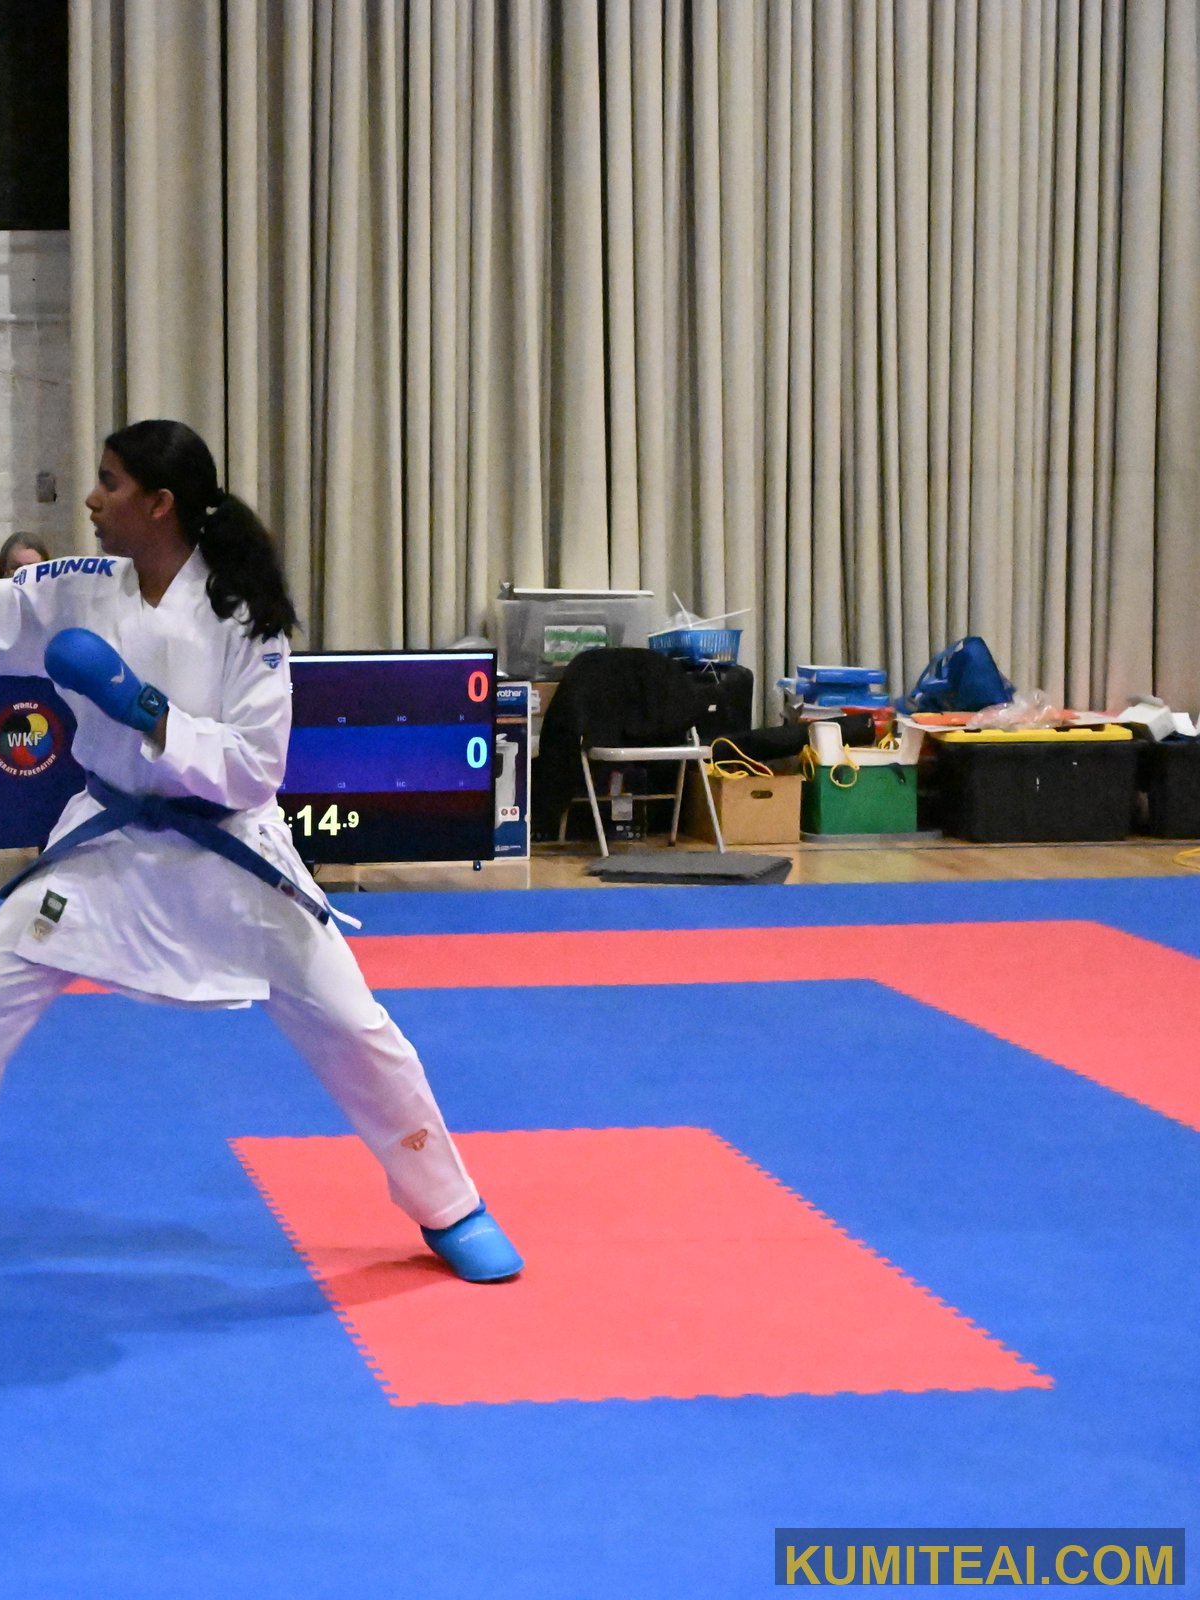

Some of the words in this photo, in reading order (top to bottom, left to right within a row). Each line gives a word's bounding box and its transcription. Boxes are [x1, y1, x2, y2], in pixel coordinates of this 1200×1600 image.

[36, 558, 117, 583] PUNOK
[468, 671, 488, 702] 0
[497, 689, 522, 698] rother
[13, 702, 39, 711] WORLD
[7, 731, 43, 747] WKF
[467, 737, 487, 768] 0
[19, 753, 57, 776] FEDERATION
